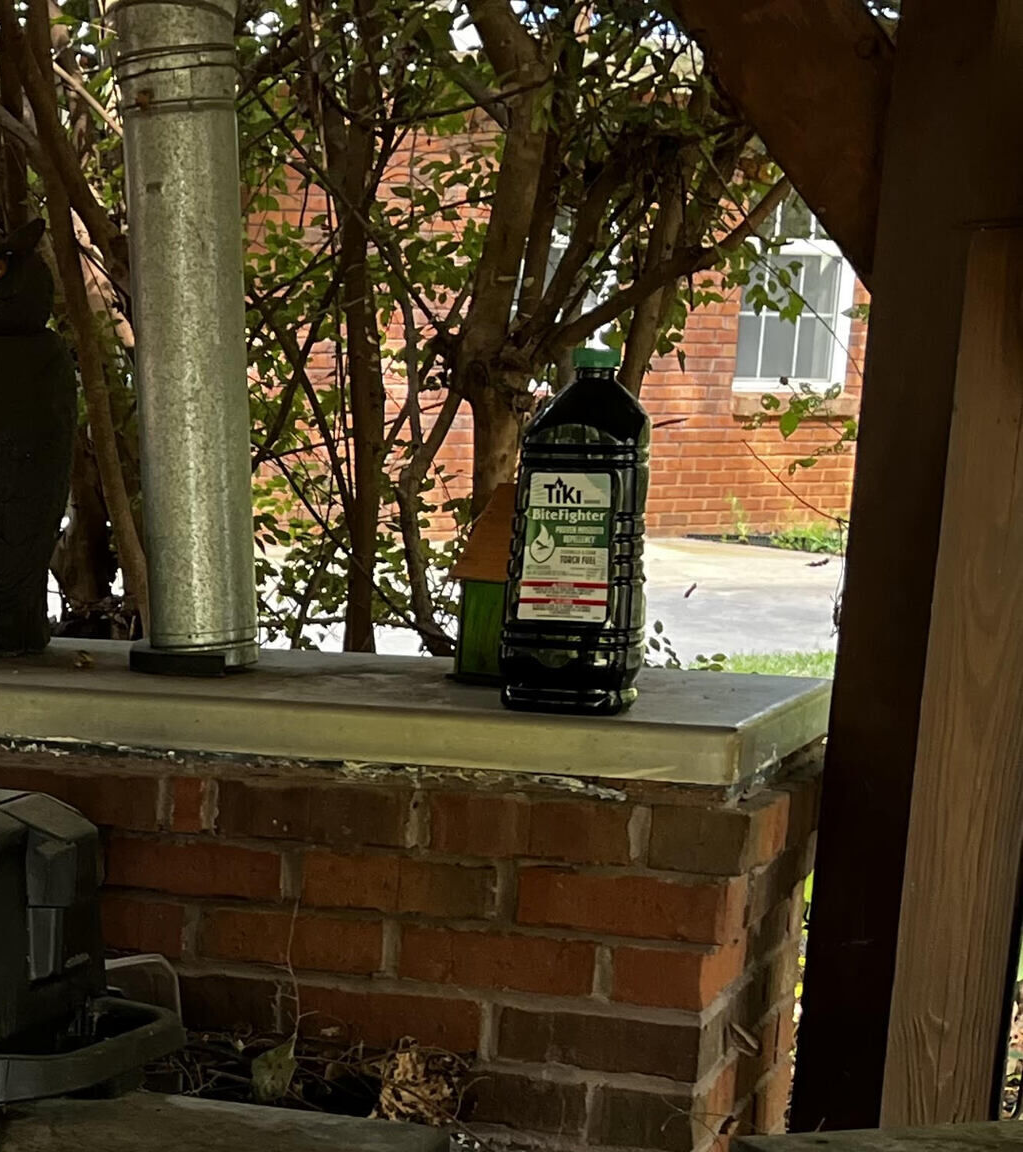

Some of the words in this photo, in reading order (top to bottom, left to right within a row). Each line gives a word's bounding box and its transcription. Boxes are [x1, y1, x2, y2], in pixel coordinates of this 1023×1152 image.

[532, 508, 606, 524] BiteFighter
[560, 555, 580, 565] TORCH
[581, 556, 596, 565] FUEL
